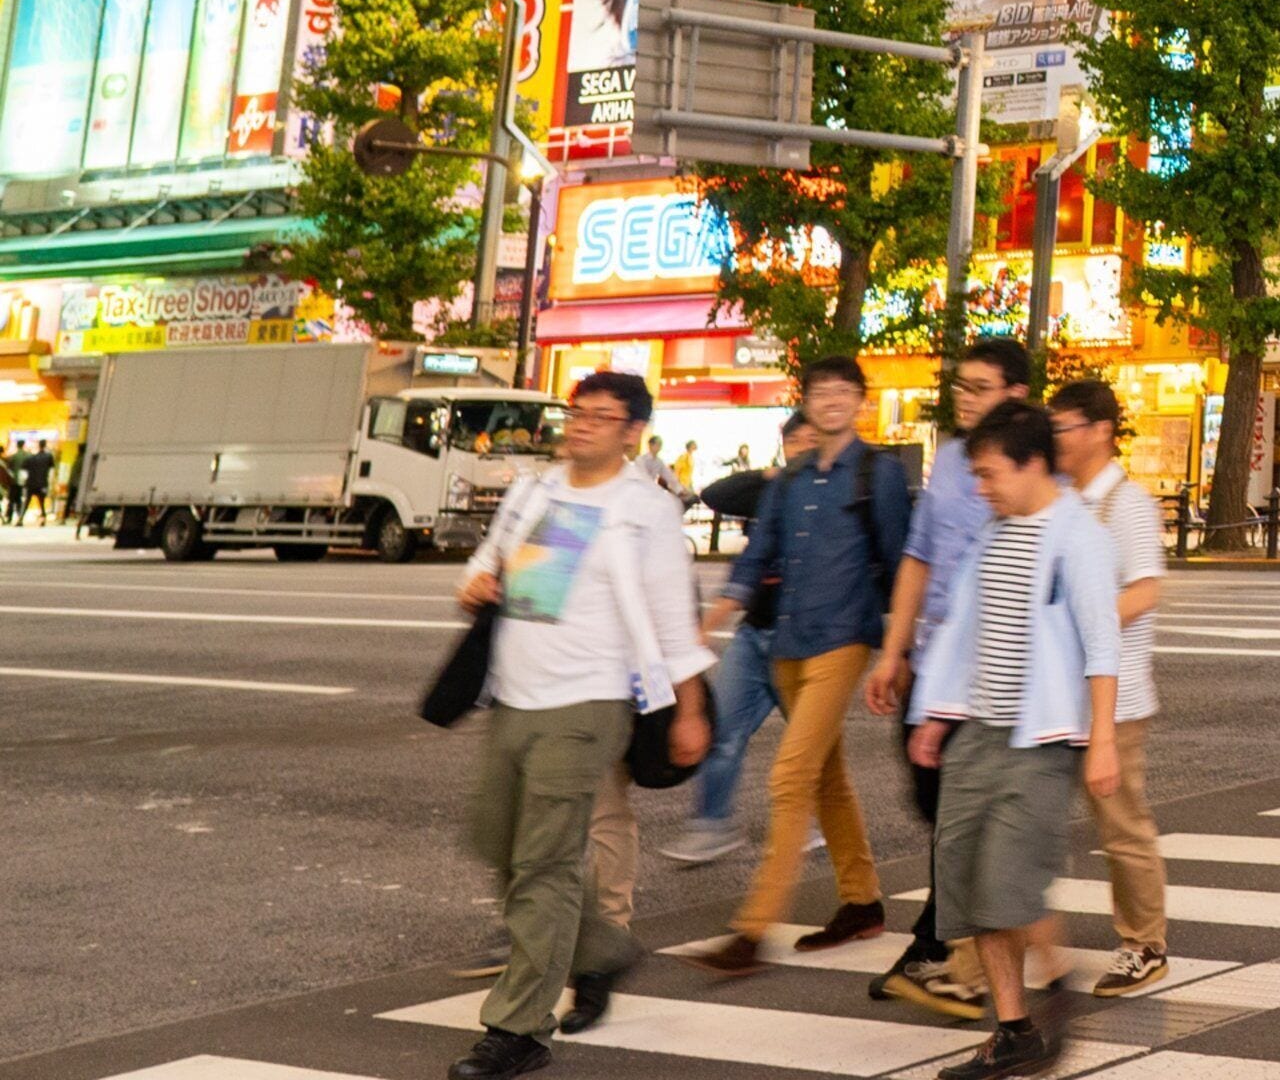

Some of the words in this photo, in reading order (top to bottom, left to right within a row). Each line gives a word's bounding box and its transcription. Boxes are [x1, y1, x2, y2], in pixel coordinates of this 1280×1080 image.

[581, 72, 621, 98] SEGA
[590, 100, 635, 124] AKIHA
[574, 194, 736, 283] SEGA
[196, 285, 251, 314] Shop
